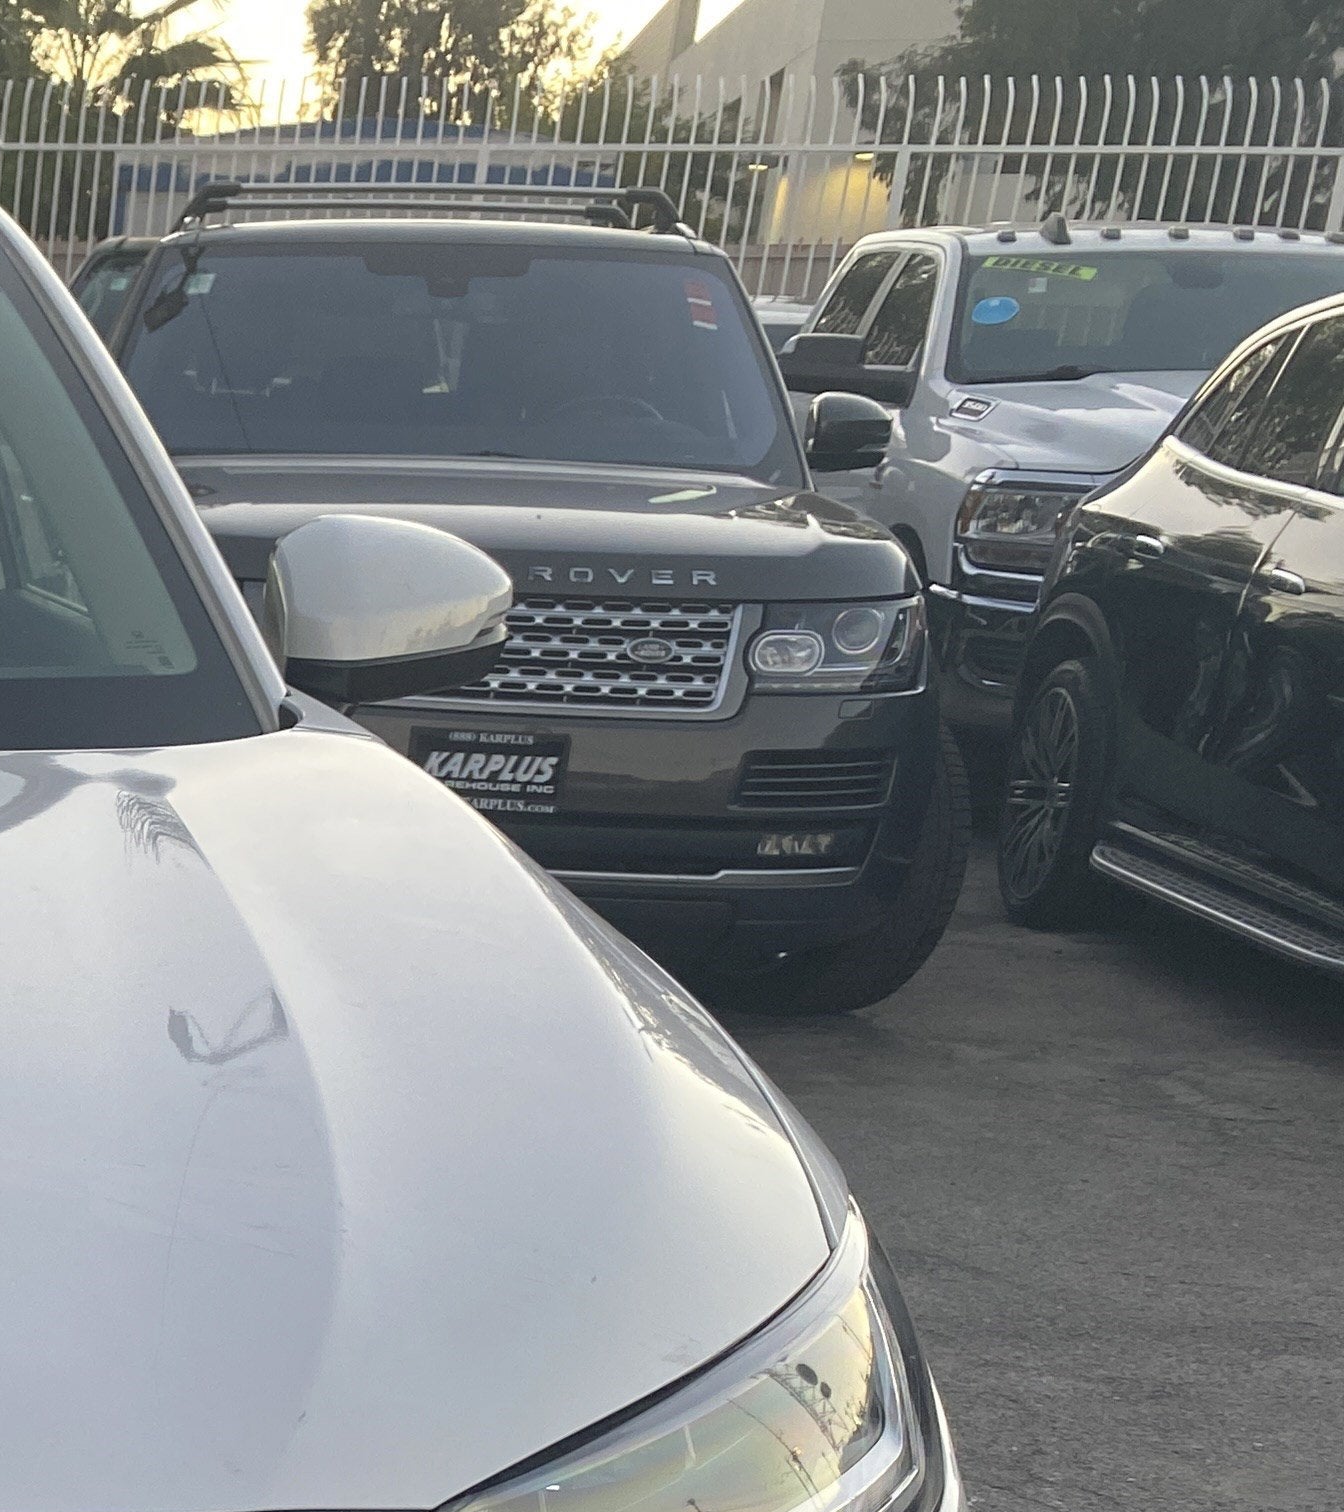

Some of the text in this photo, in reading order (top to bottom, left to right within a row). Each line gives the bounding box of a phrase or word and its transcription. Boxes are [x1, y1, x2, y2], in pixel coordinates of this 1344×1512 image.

[992, 256, 1083, 278] DIESEL
[527, 565, 718, 586] ROVER
[478, 733, 534, 745] KARPLUS
[424, 751, 559, 784] KARPLUS
[526, 784, 555, 794] INC
